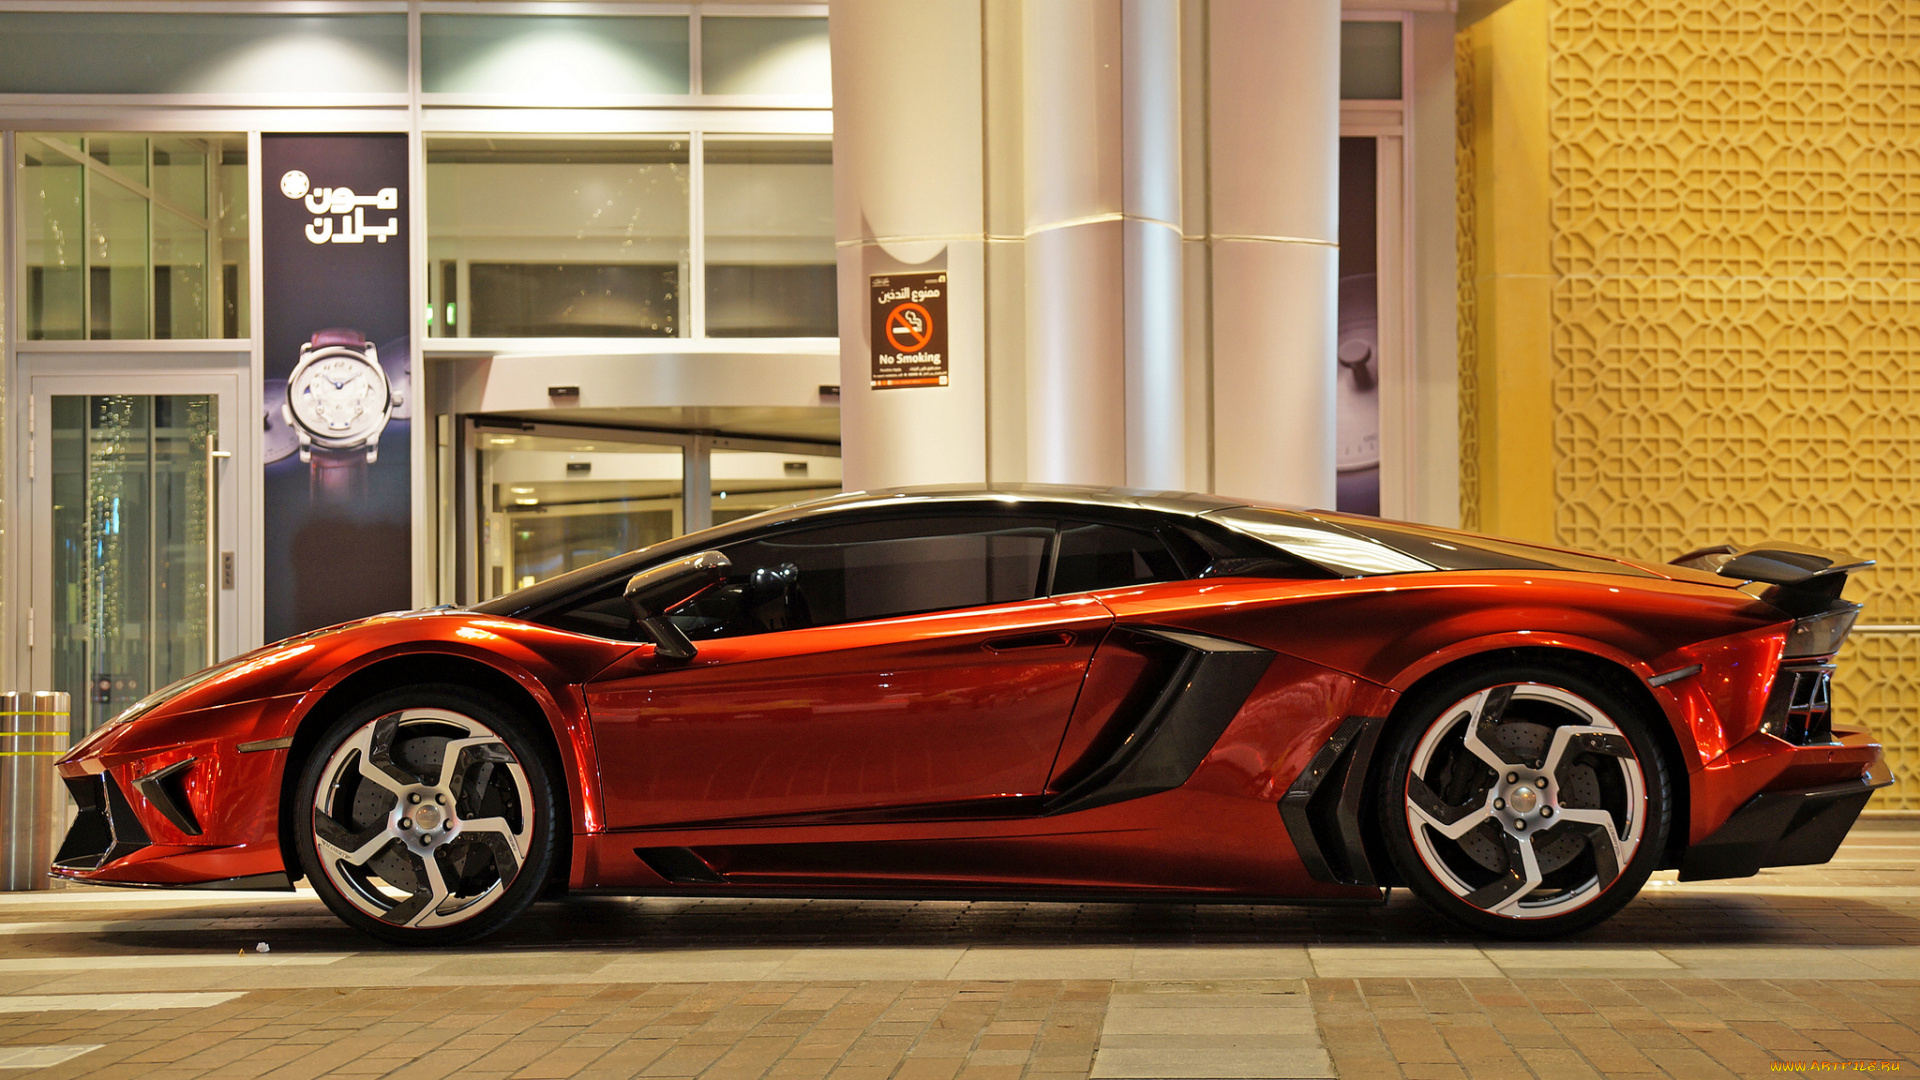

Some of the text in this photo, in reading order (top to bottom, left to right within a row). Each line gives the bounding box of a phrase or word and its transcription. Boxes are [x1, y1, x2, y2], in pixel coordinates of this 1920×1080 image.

[304, 207, 398, 245] بلان
[878, 286, 940, 305] ممنوع التدخين
[879, 352, 941, 365] No Smoking
